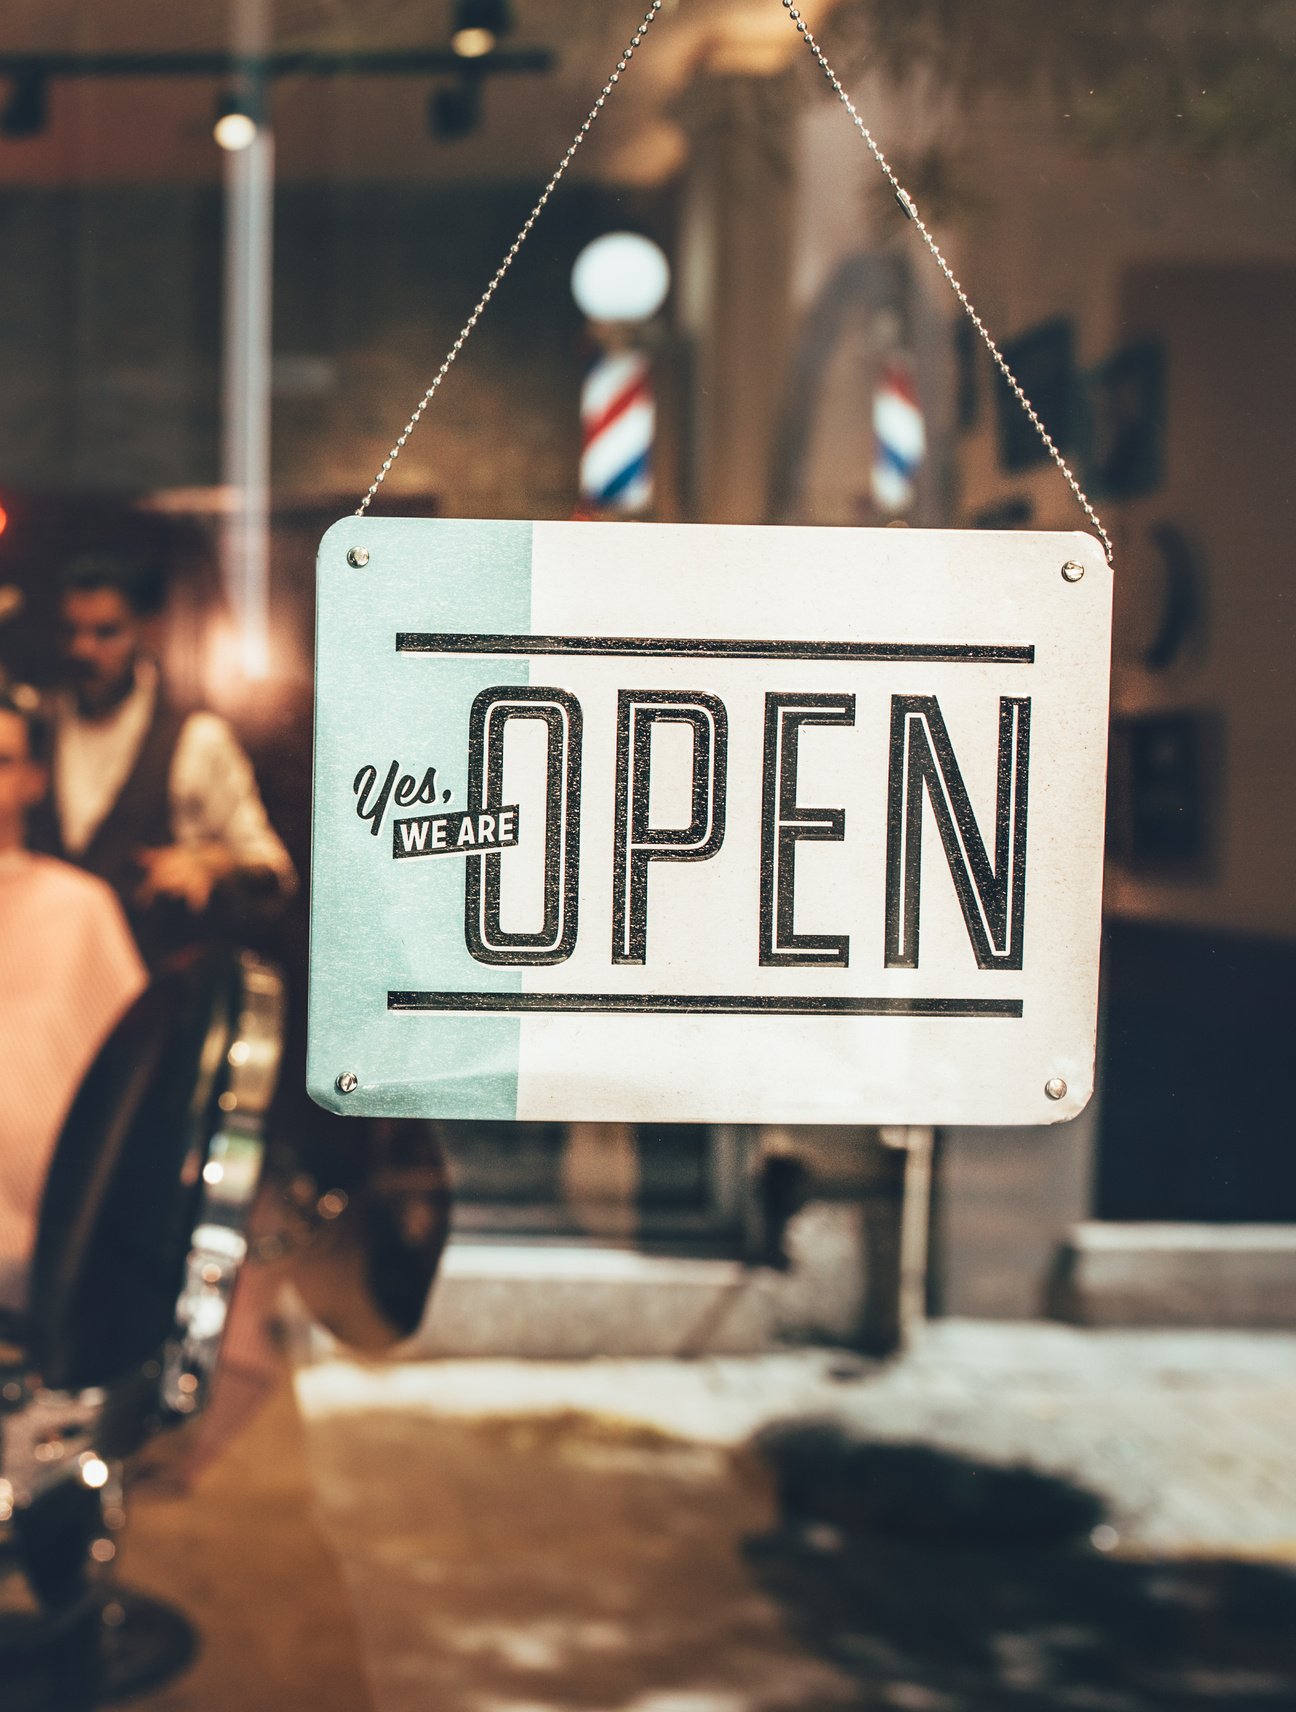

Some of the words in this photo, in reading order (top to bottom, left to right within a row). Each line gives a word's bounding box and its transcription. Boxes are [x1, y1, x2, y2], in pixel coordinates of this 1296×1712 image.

[353, 760, 451, 836] Yes,
[399, 819, 447, 852] WE
[456, 811, 514, 846] ARE
[465, 686, 1031, 970] OPEN
